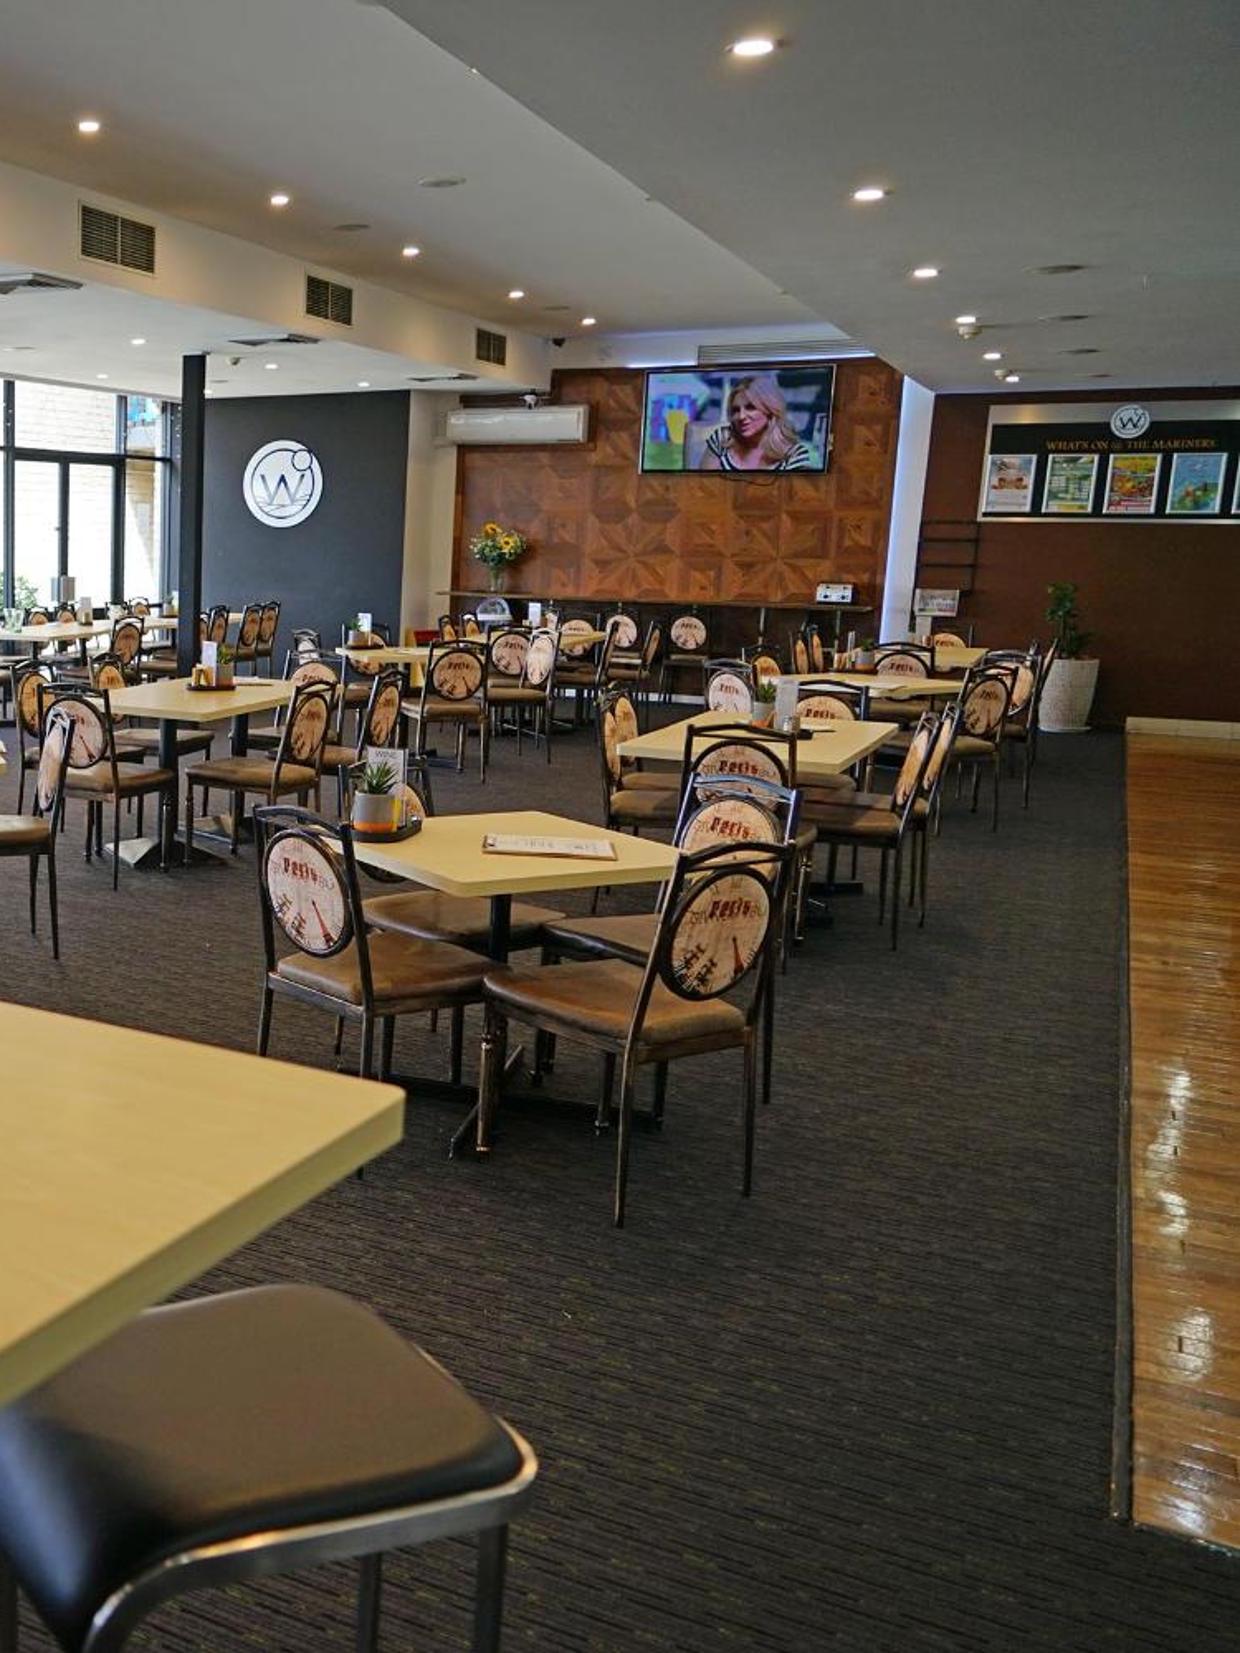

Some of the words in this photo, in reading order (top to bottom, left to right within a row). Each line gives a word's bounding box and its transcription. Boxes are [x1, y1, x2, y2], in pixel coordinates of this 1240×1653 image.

[1127, 439, 1149, 449] THE
[1152, 438, 1217, 449] MARINERS
[805, 708, 835, 719] Paris
[718, 760, 759, 774] Paris
[710, 817, 751, 839] Paris
[709, 898, 751, 918] Paris
